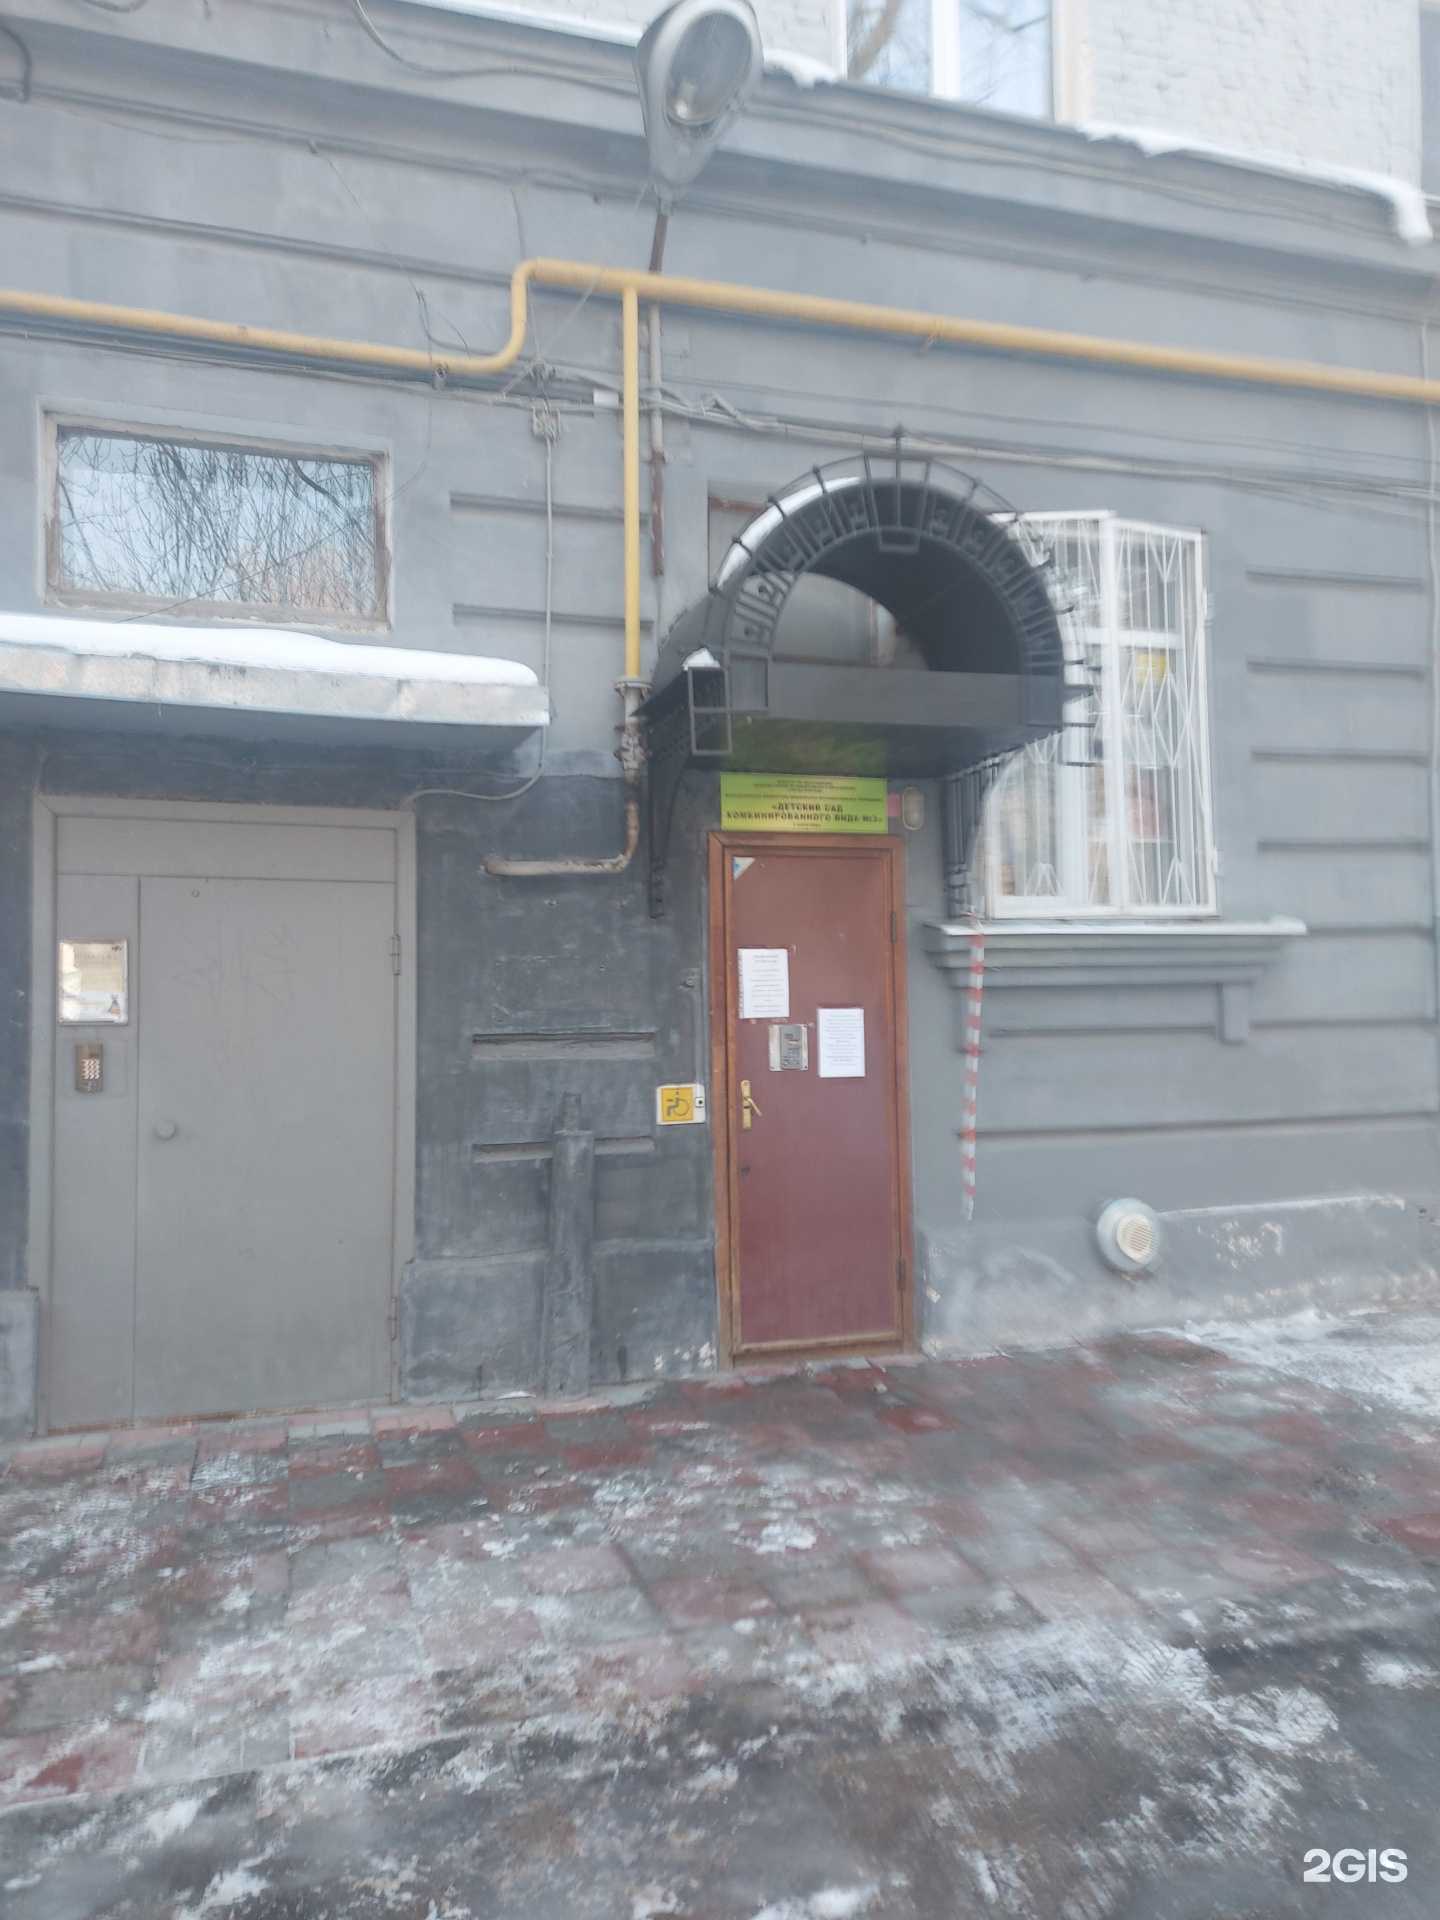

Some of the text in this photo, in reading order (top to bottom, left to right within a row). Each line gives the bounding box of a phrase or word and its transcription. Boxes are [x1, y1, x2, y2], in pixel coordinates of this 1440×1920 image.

[824, 804, 843, 813] САД
[727, 810, 832, 821] КОМБИНИРОВАННОГО
[835, 813, 859, 822] ВИДА
